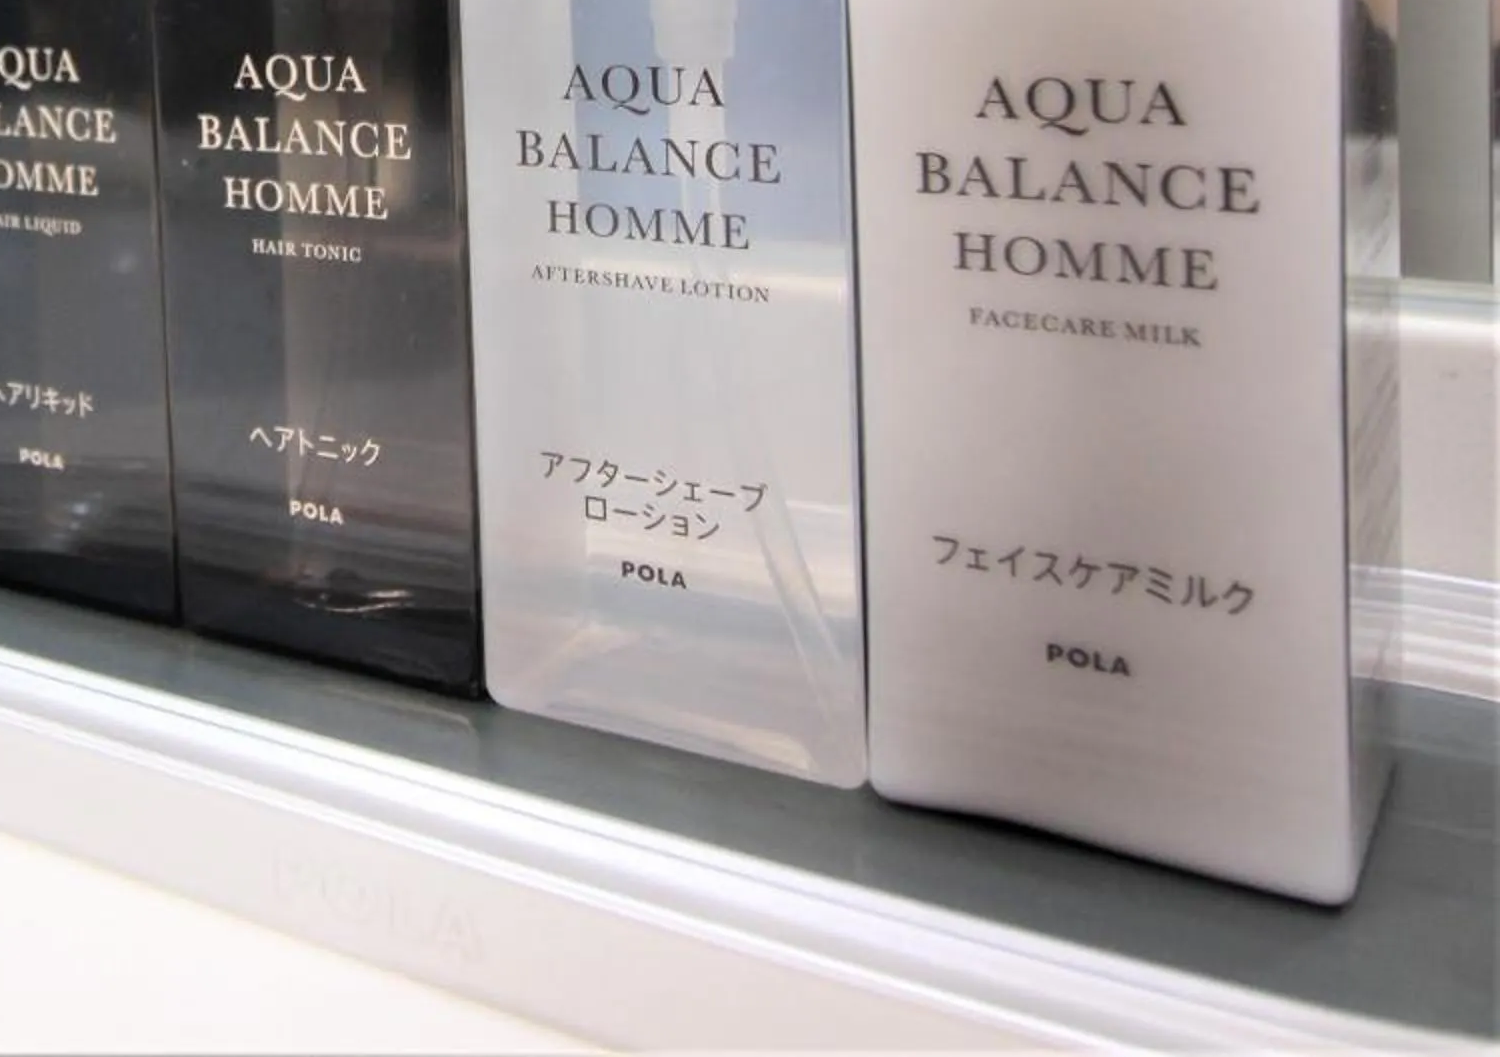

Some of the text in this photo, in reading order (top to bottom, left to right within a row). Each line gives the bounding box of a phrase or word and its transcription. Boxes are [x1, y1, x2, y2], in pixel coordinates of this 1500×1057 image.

[234, 54, 366, 101] AQUA
[564, 63, 724, 115] AQUA
[975, 76, 1186, 136] AQUA
[198, 114, 412, 159] BALANCE
[516, 131, 782, 184] BALANCE
[224, 177, 388, 219] HOMME
[916, 152, 1259, 214] BALANCE
[25, 217, 81, 237] LIQUID
[548, 201, 750, 250] HOMME
[252, 239, 361, 263] HAIR TONIC
[954, 231, 1219, 291] HOMME
[531, 265, 770, 303] AFTERSHAVE LOTION
[969, 307, 1202, 348] FACECARE MILK
[19, 449, 65, 470] POLA
[250, 426, 380, 466] ヘアトニック
[540, 452, 768, 512] アフターシェーブ
[290, 500, 344, 525] POLA
[586, 497, 720, 540] ローション
[622, 561, 687, 589] POLA
[932, 534, 1254, 615] フェイスケアミルク
[1047, 642, 1131, 676] POLA
